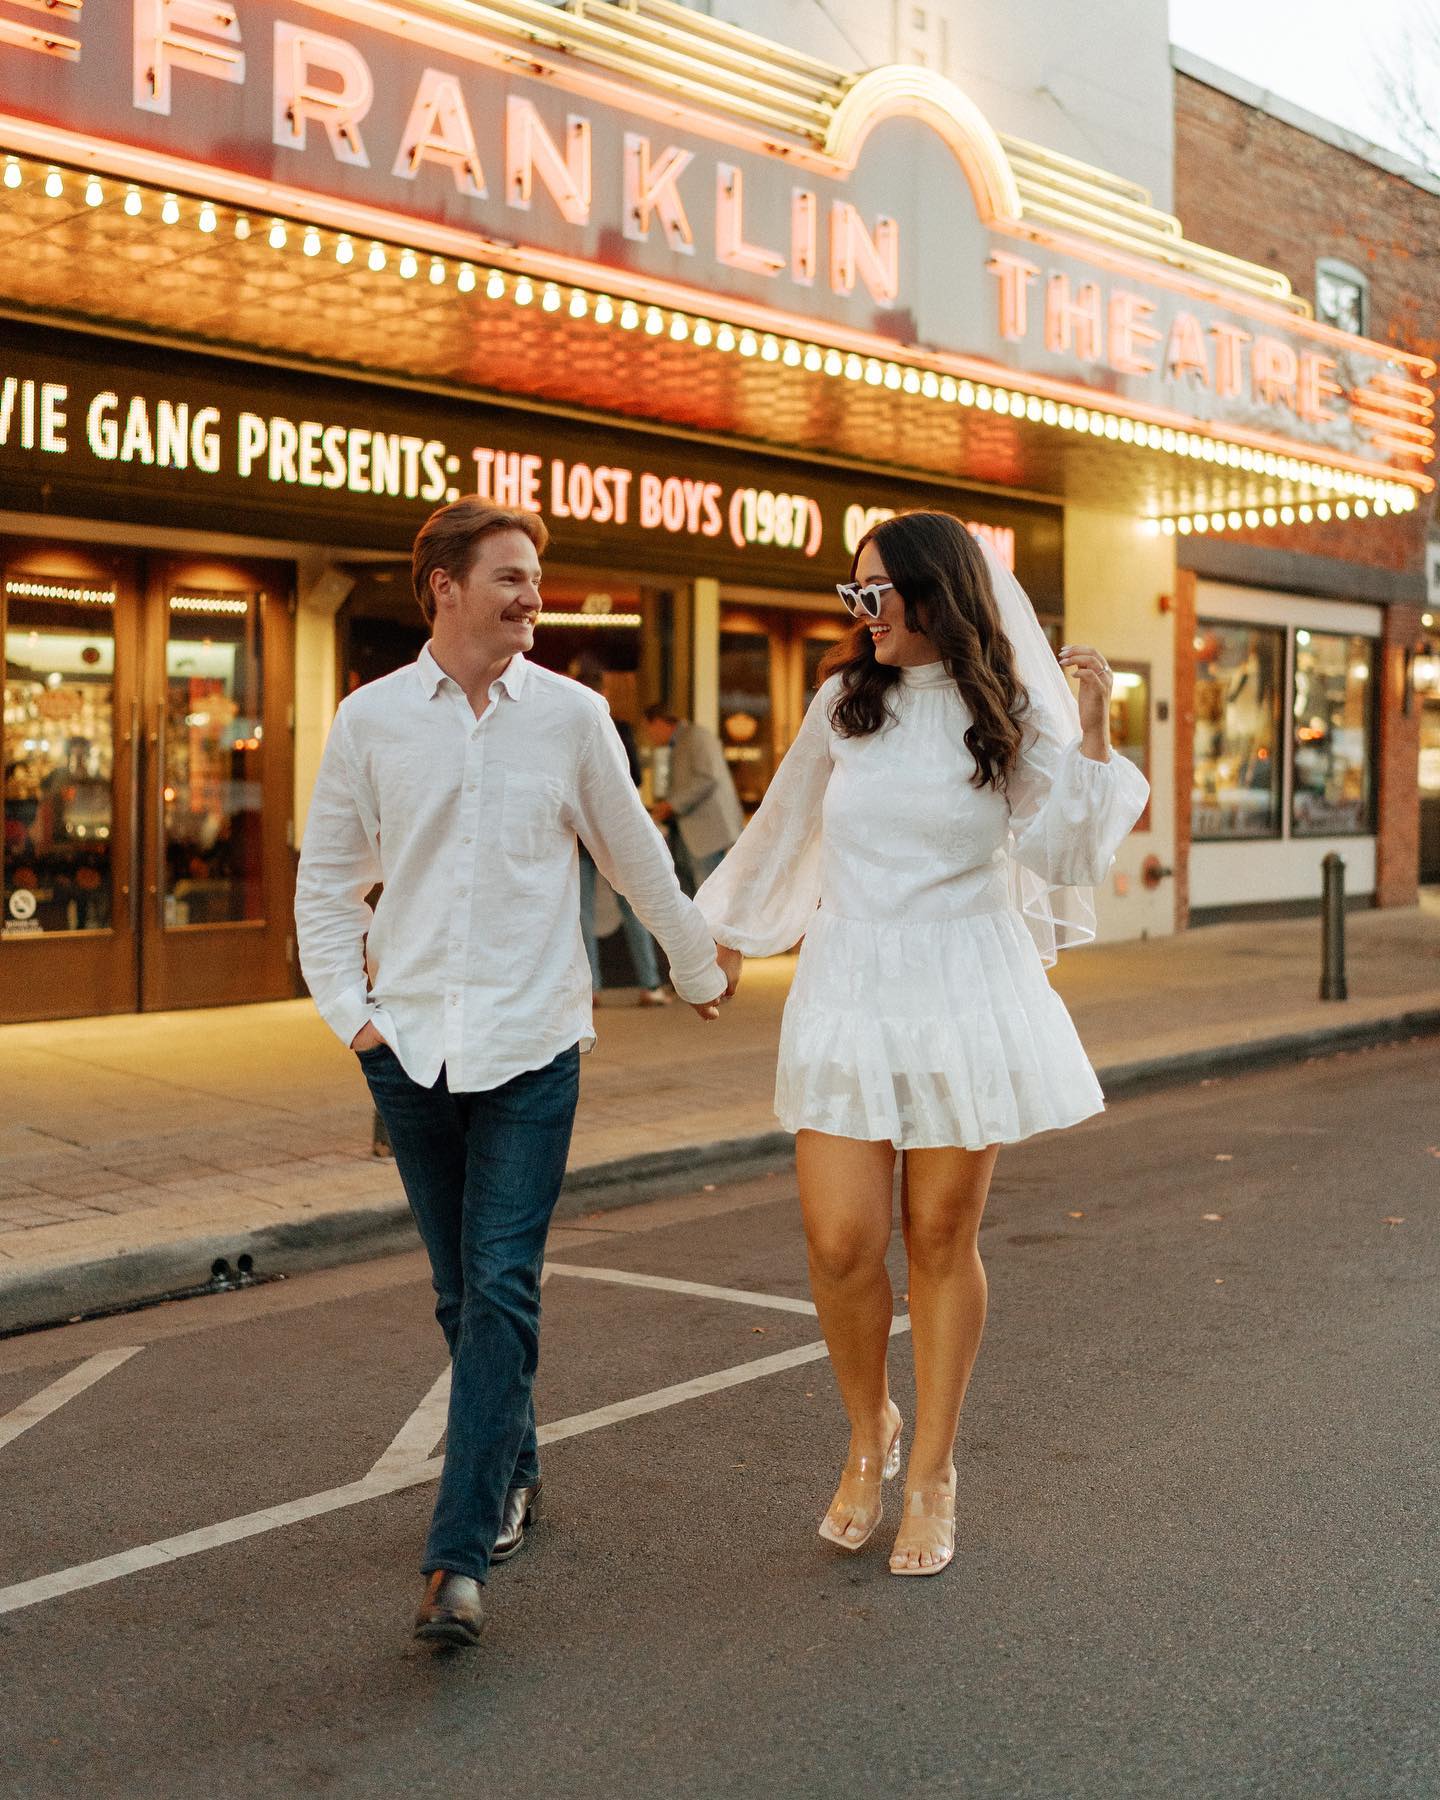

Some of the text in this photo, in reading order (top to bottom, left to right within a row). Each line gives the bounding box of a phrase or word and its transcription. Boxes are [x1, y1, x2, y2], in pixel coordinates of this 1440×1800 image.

[133, 0, 1342, 424] FRANKLIN THEATRE
[87, 391, 221, 473] GANG
[237, 411, 460, 502] PRESENTS:
[472, 446, 541, 513] THE
[551, 458, 632, 524] LOST
[640, 472, 722, 536] BOYS
[729, 487, 822, 557] (1987)
